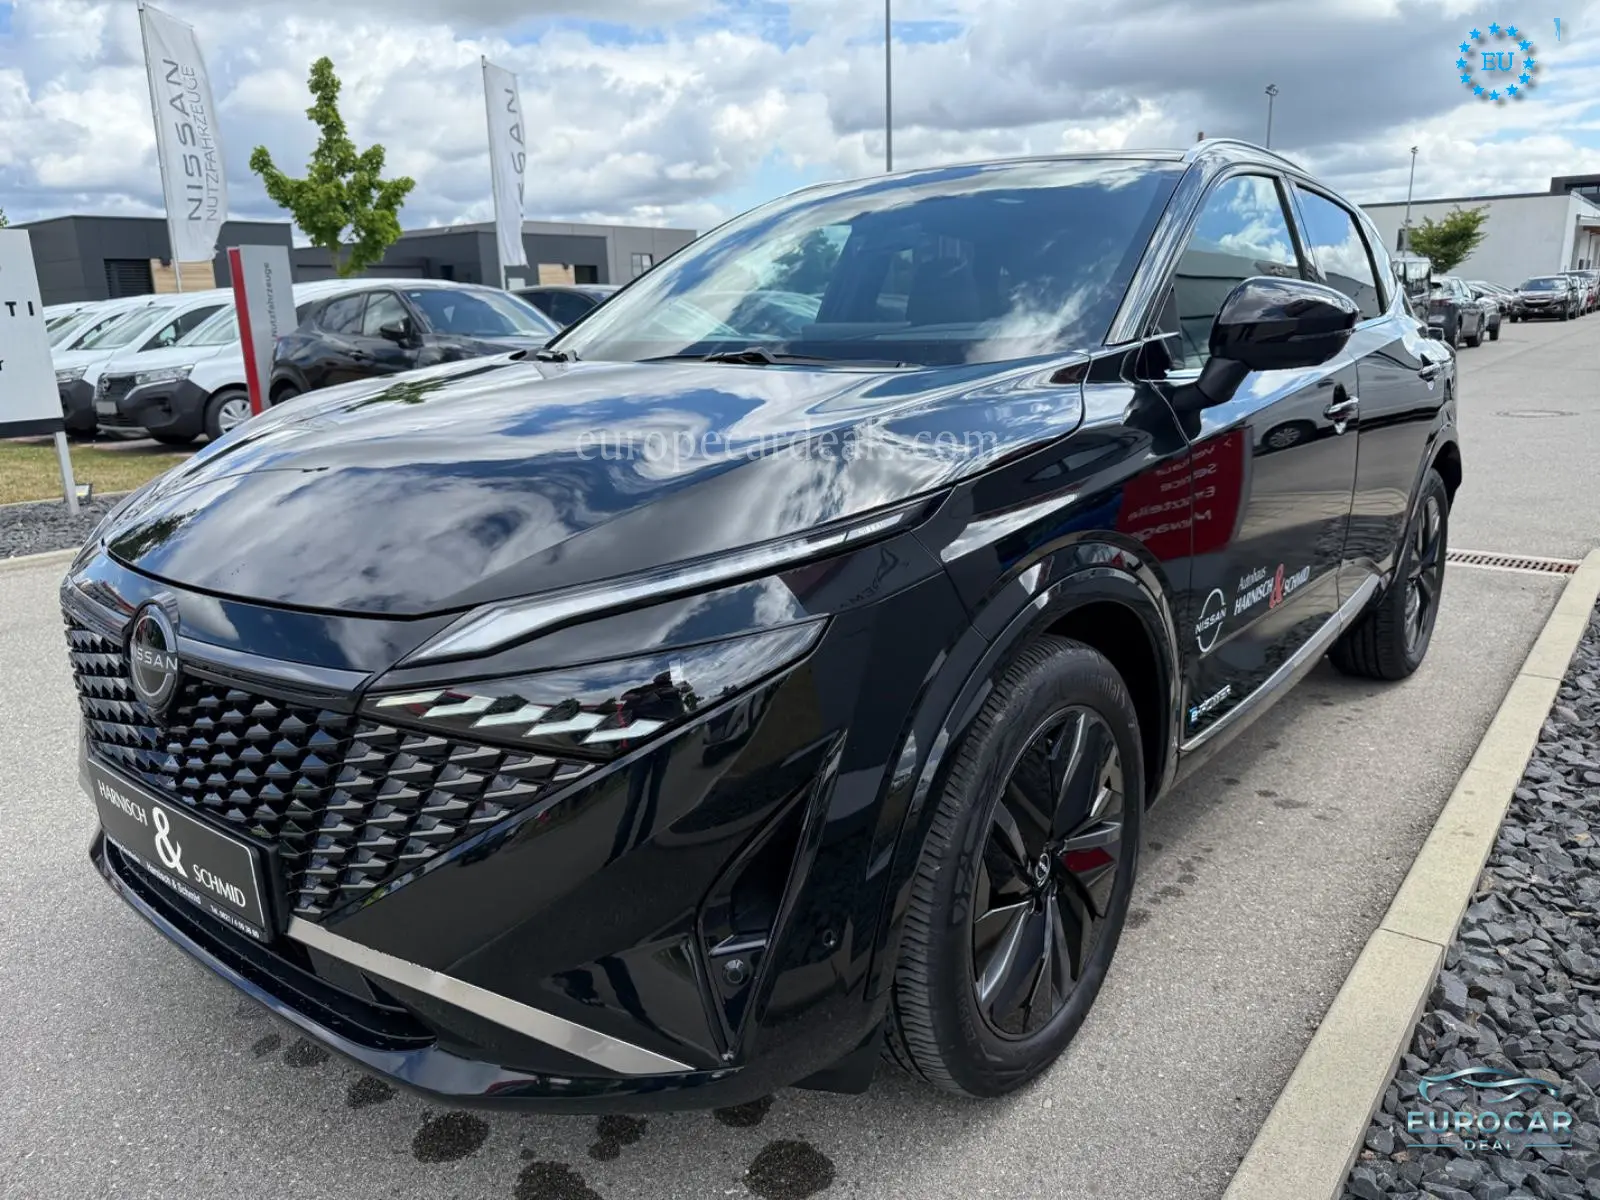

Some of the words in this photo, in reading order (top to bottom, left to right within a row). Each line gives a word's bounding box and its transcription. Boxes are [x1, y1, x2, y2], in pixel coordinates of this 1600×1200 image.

[162, 58, 204, 221] NISSAN
[181, 63, 219, 222] NUTZFAHRZEUGE
[1194, 607, 1227, 635] NISSAN
[1234, 577, 1275, 616] HARNISCH
[1269, 563, 1285, 609] &
[1283, 565, 1311, 596] SCHMID
[97, 778, 149, 827] HARNISCH
[152, 806, 188, 879] &
[193, 863, 247, 908] SCHMID
